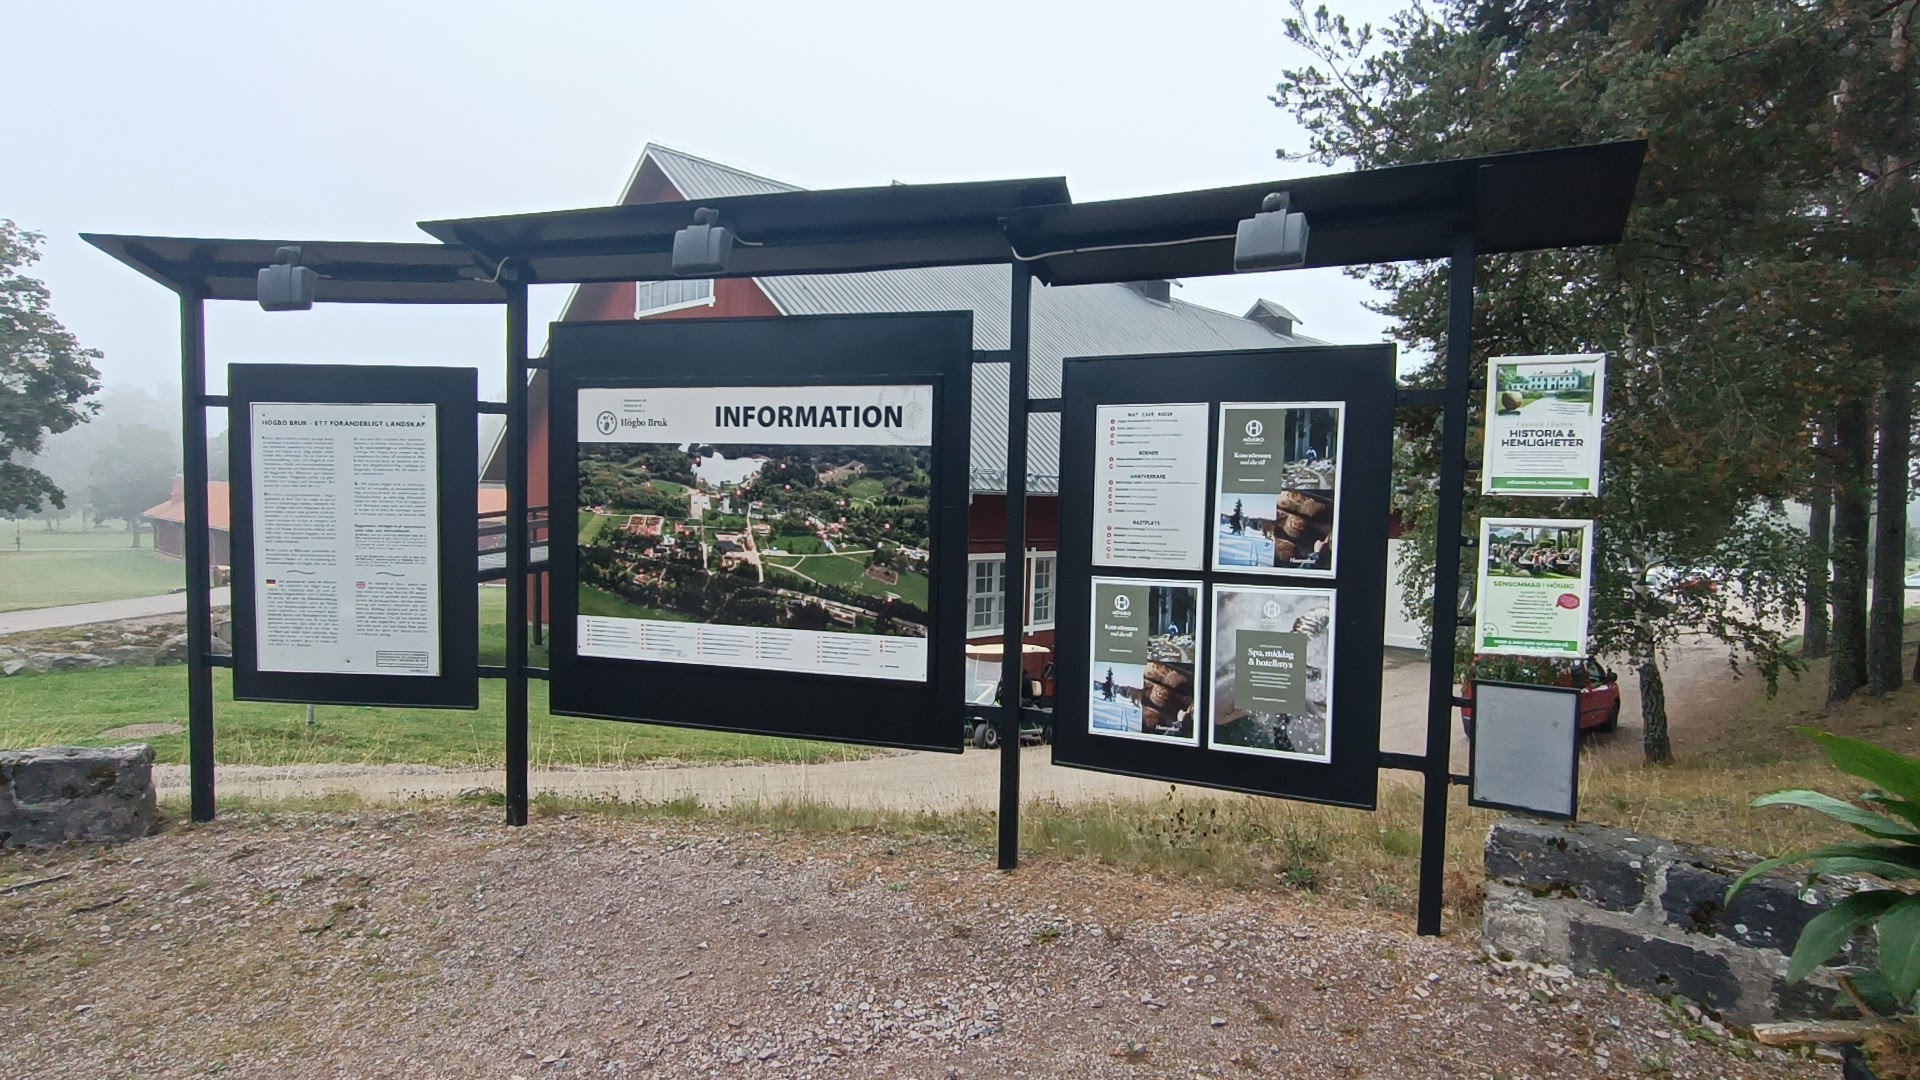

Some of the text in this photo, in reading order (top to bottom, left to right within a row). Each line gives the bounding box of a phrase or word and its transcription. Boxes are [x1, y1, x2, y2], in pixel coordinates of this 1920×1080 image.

[715, 405, 903, 428] INFORMATION
[620, 418, 668, 429] Högbo Bruk
[1509, 429, 1576, 438] HISTORIA &
[1501, 438, 1584, 447] HEMLIGHETER
[1493, 580, 1541, 588] SENSOMMAR
[1247, 648, 1295, 660] Spa, middag
[1247, 658, 1293, 669] & hotellmys
